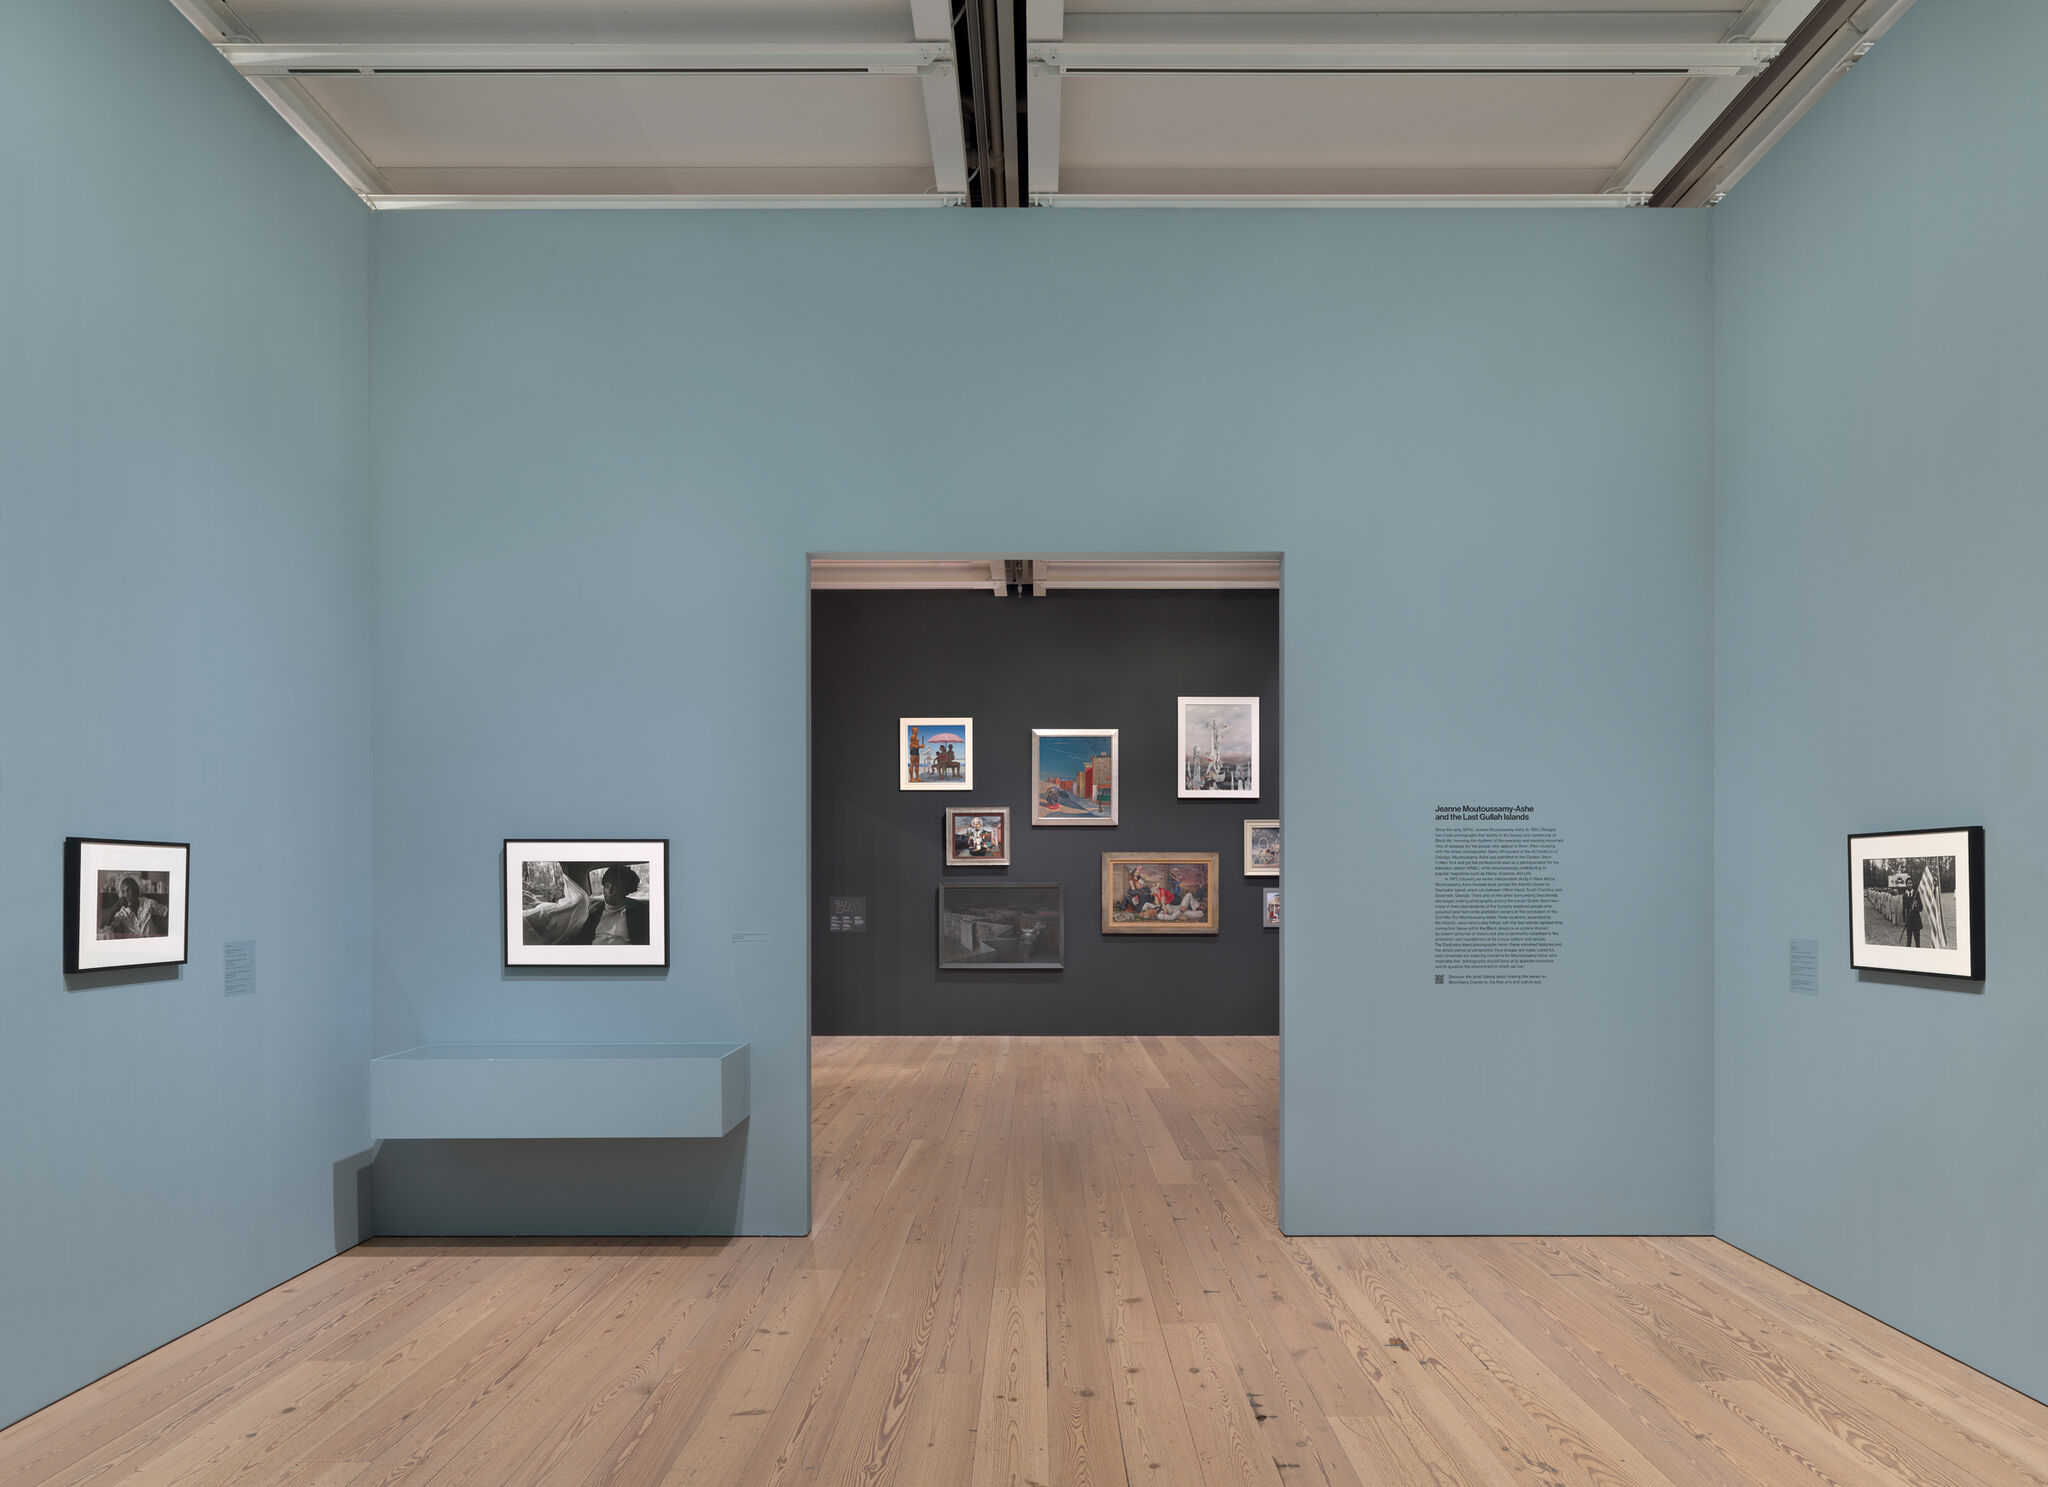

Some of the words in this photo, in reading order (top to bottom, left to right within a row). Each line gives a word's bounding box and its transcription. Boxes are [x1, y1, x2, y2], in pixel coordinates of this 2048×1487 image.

[1463, 805, 1534, 814] Moutoussamy-Ashe
[1479, 813, 1503, 821] Gullah
[1504, 813, 1529, 821] Islands
